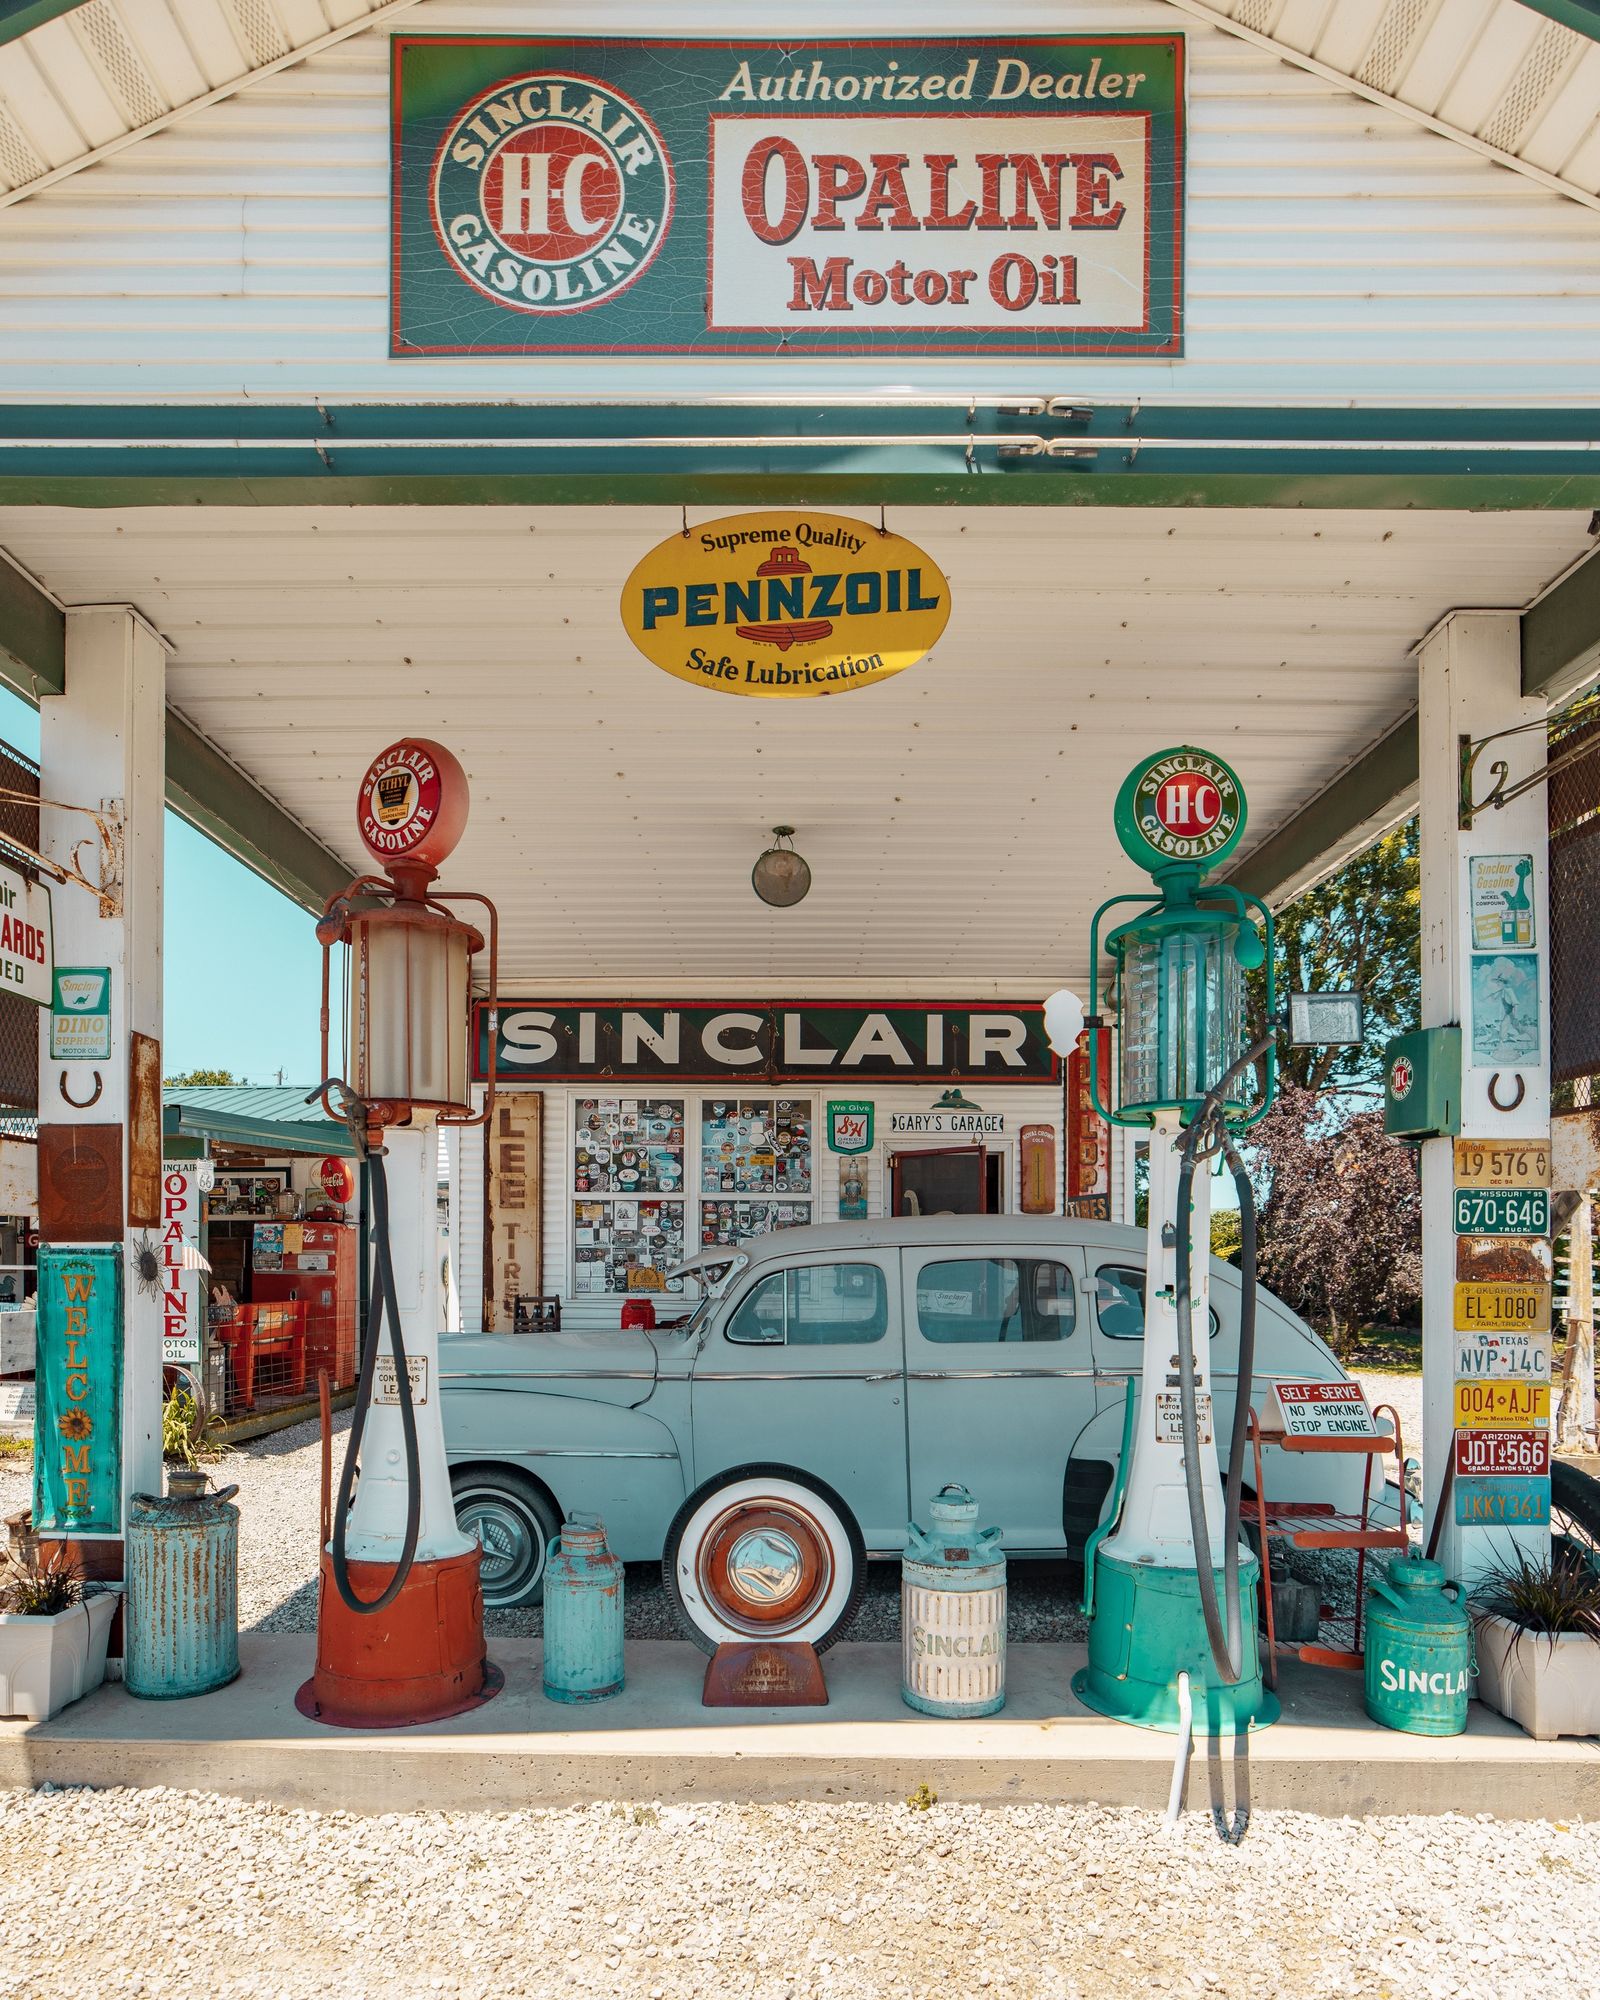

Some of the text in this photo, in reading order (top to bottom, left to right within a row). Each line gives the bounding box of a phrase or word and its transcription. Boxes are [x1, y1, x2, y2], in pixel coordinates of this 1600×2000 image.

[718, 60, 1147, 102] Authorized Dealer
[451, 81, 658, 177] SINCLAIR
[741, 135, 1126, 246] OPALINE
[447, 211, 657, 301] GASOLINE
[786, 252, 1082, 313] Motor Oil
[699, 522, 867, 555] Supreme Quality
[641, 567, 942, 630] PENNZOIL
[685, 648, 885, 686] Safe Lubrication
[363, 749, 435, 797] SINCLAIR
[380, 775, 409, 792] ETHYL
[1141, 756, 1235, 798] SINCLAIR
[363, 806, 434, 850] GASOLINE
[1140, 813, 1236, 857] GASOLINE
[1477, 862, 1513, 875] Sinclair
[1476, 876, 1516, 889] Gasoline
[62, 979, 101, 992] Sinclair
[57, 1017, 105, 1034] DINO
[55, 1036, 106, 1046] SUPREME
[62, 1047, 99, 1055] MOTOR OIL
[500, 1012, 1027, 1066] SINCLAIR
[898, 1115, 998, 1132] GARY'S GARAGE
[499, 1108, 526, 1209] LEE
[1458, 1142, 1486, 1152] Illinois
[1460, 1152, 1484, 1176] 19
[1491, 1152, 1528, 1176] 576
[200, 1174, 212, 1189] 66
[1458, 1199, 1545, 1226] 670-646
[1476, 1239, 1516, 1247] KANSAS
[1476, 1287, 1528, 1295] OKLAHOMA
[1533, 1287, 1545, 1295] 67
[1499, 1336, 1529, 1345] TEXAS
[166, 1350, 186, 1358] OIL
[1461, 1348, 1545, 1373] NVP 14C
[1289, 1403, 1365, 1417] NO SMOKING
[1460, 1387, 1544, 1414] 004 AJF
[1291, 1419, 1371, 1433] STOP ENGINE
[1461, 1440, 1545, 1466] JDT 566
